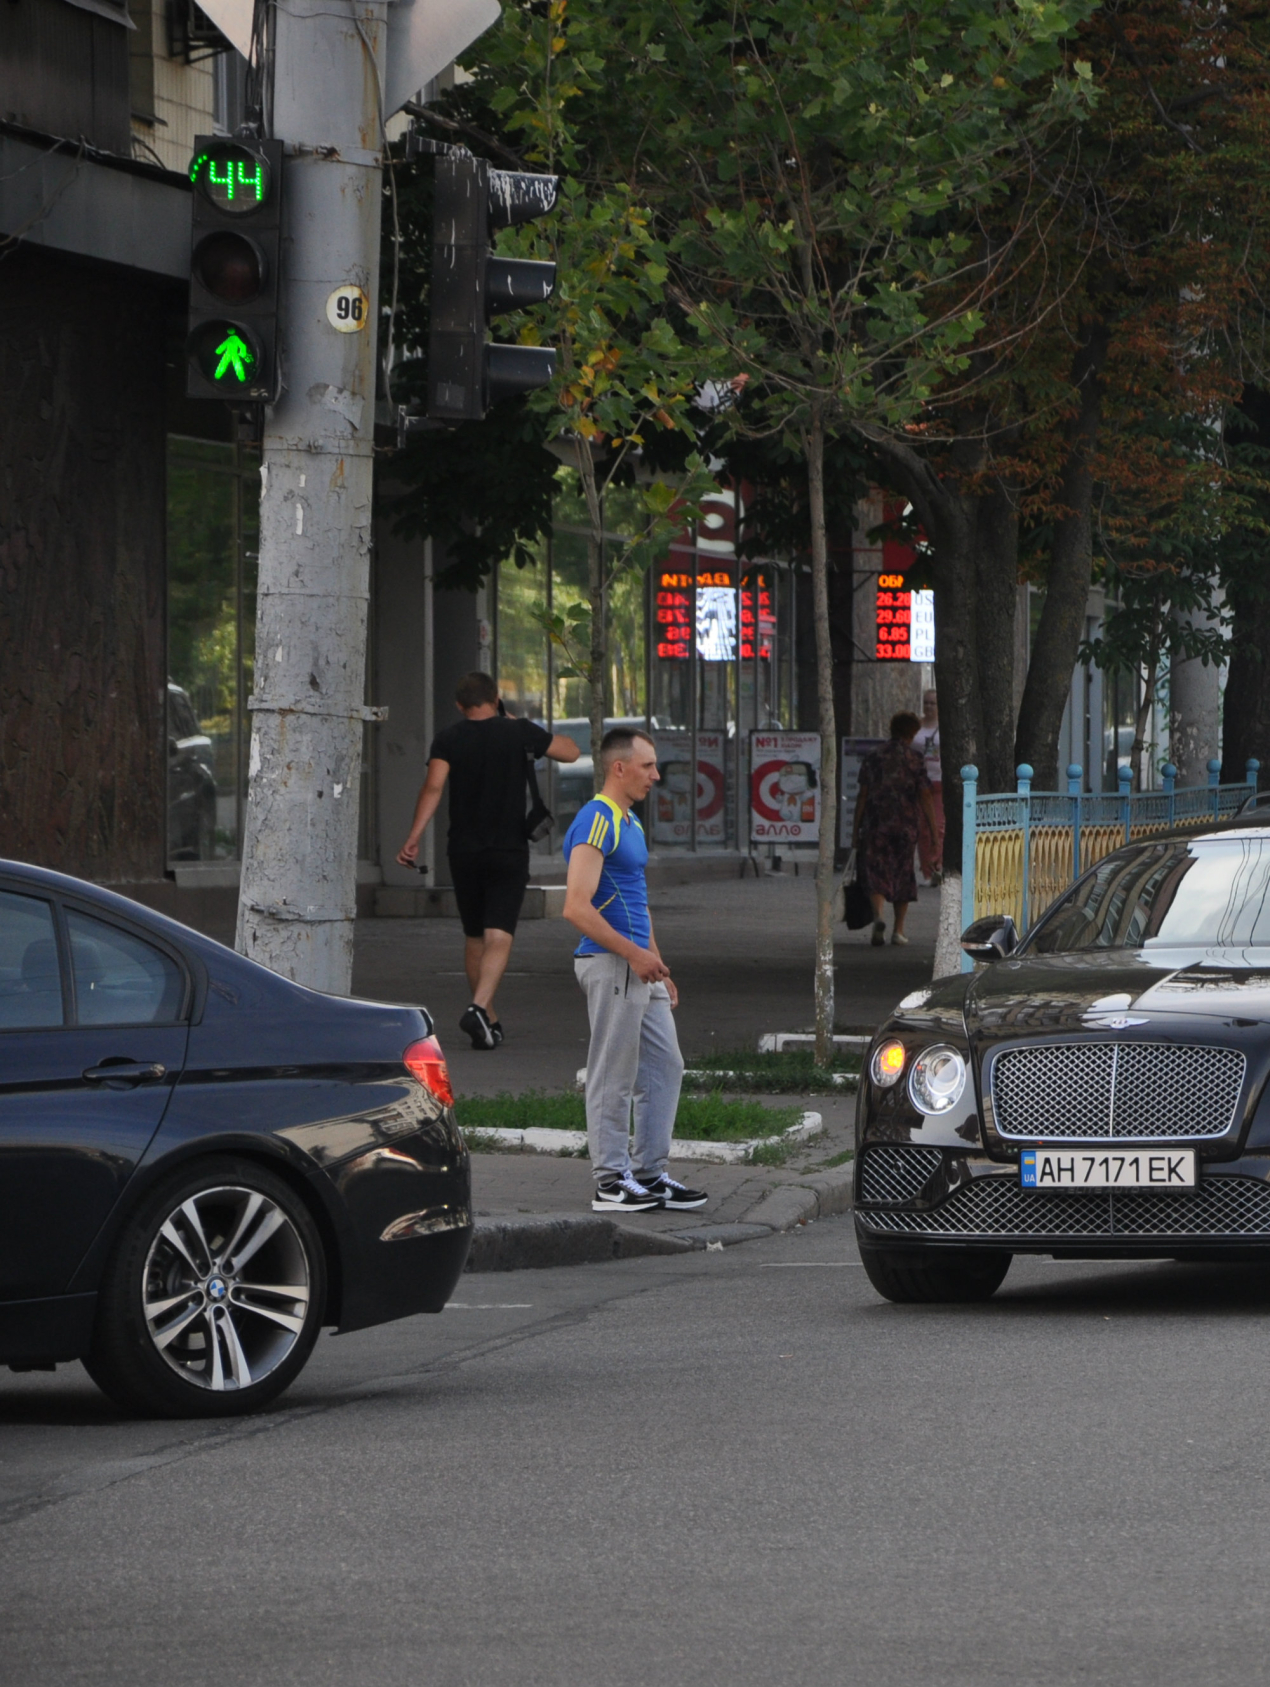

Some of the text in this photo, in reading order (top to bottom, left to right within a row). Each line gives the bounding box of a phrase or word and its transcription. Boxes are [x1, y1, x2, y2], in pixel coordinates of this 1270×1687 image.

[209, 161, 263, 200] 44
[336, 296, 363, 321] 96
[914, 593, 934, 606] US
[915, 611, 933, 623] EU
[914, 645, 933, 658] GB
[1023, 1173, 1036, 1183] UA
